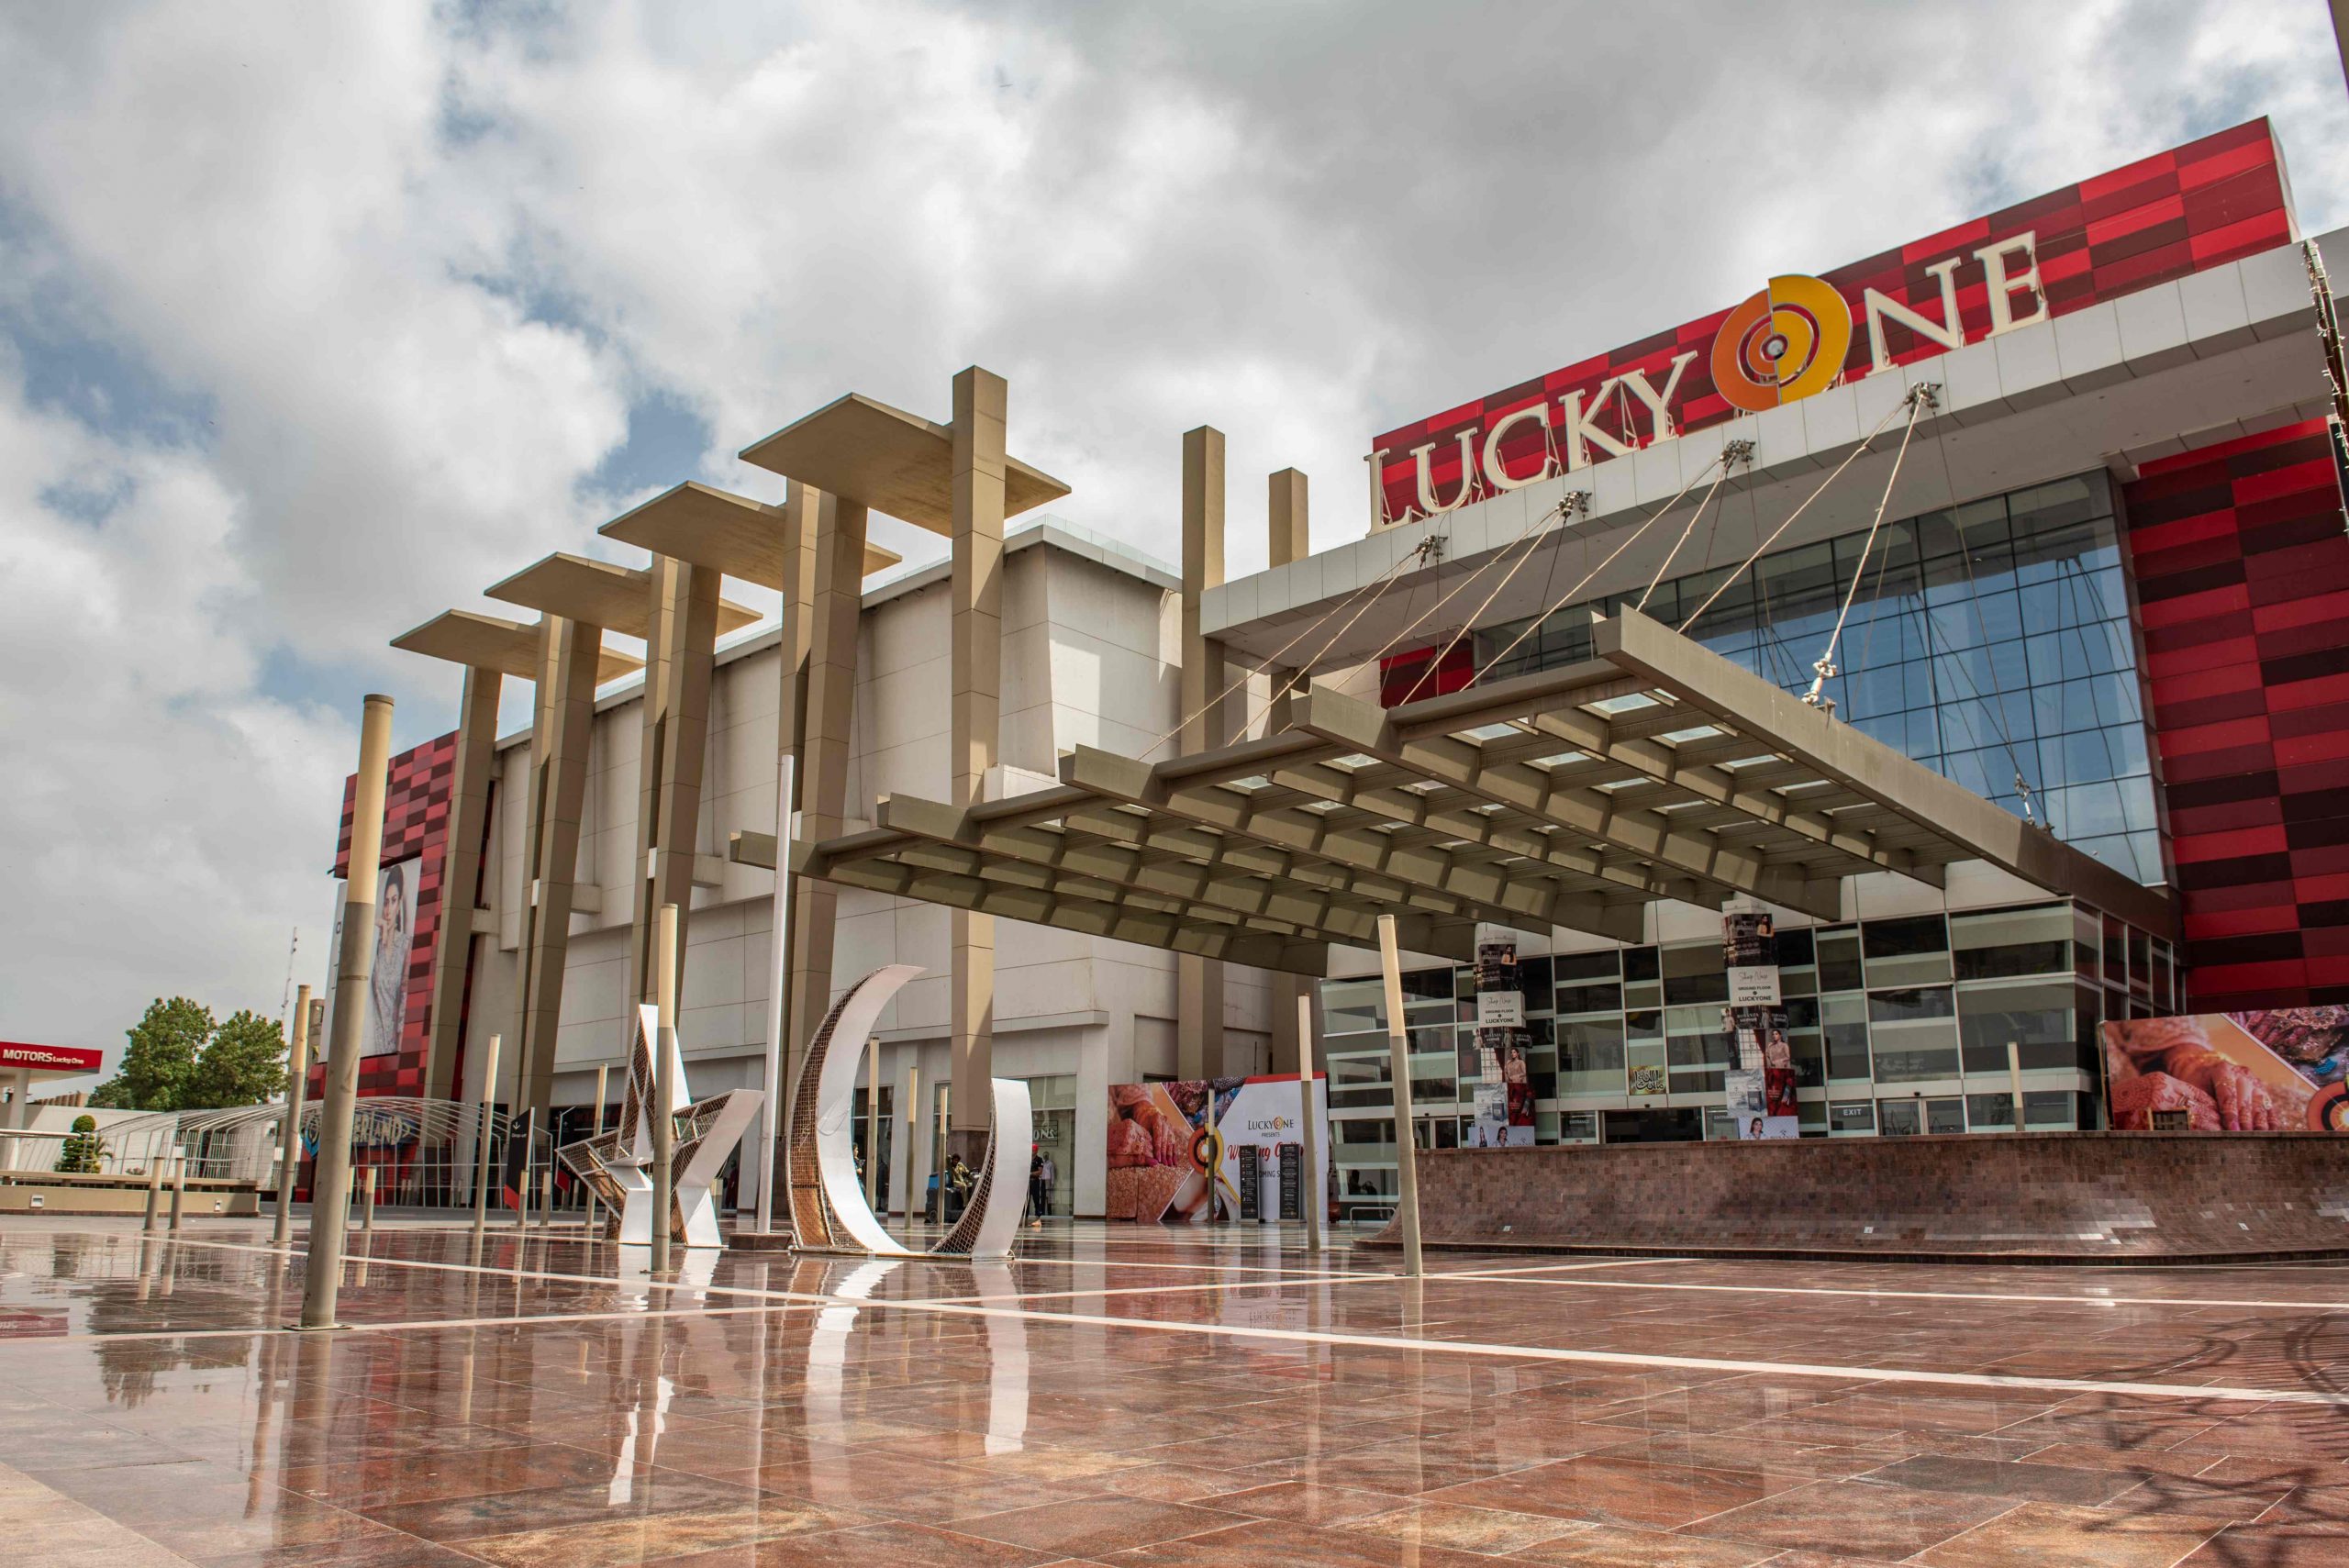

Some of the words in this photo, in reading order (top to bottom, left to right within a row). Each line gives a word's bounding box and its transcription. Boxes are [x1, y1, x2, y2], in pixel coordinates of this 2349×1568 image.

[1364, 350, 1698, 539] LUCKY
[3, 1049, 53, 1062] MOTORS
[52, 1056, 71, 1064] Lucky
[1842, 1108, 1862, 1117] EXIT
[1259, 1170, 1276, 1178] OMING
